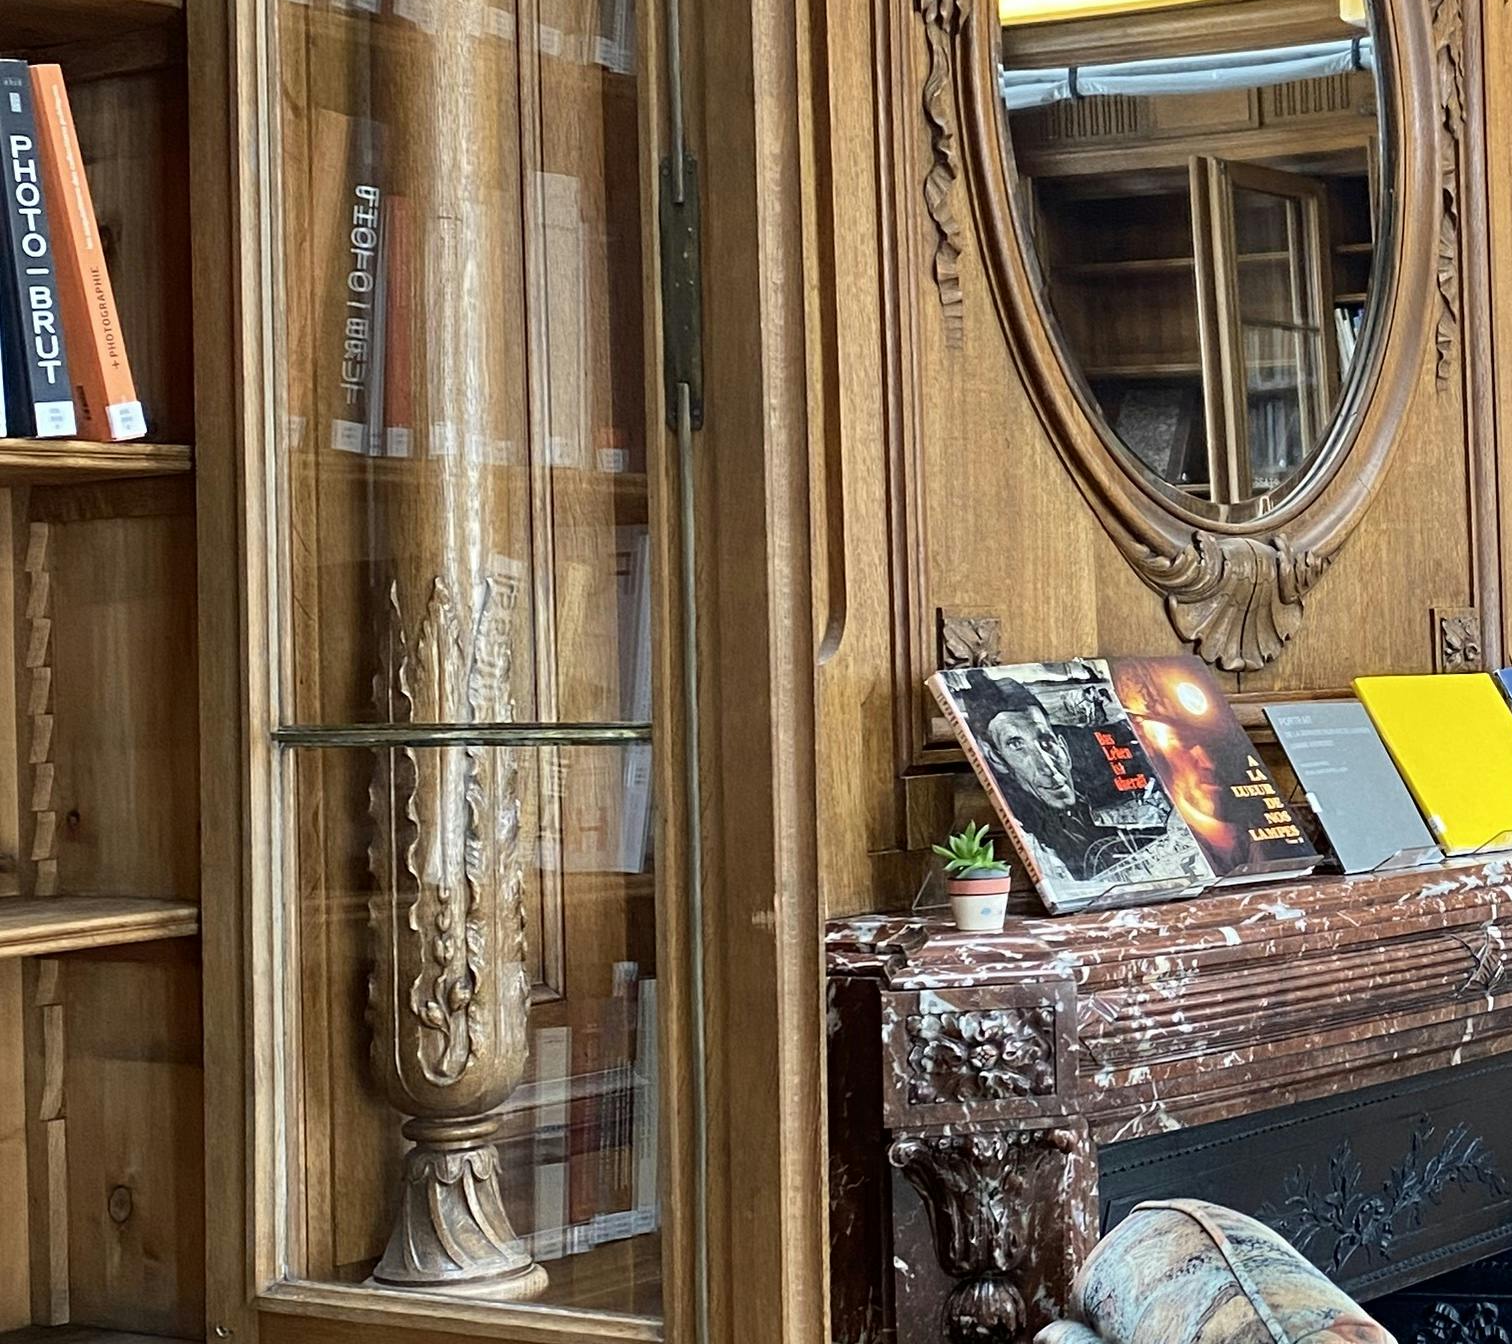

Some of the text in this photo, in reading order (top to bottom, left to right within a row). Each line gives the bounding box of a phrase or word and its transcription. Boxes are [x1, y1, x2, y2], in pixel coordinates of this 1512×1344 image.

[10, 134, 48, 258] PHOTO
[29, 285, 62, 384] BRUT
[92, 265, 117, 360] PHOTOGRAPHIE
[1247, 755, 1260, 767] A
[1246, 769, 1267, 782] LA
[1230, 783, 1276, 798] LUEUR
[1263, 797, 1285, 811] DE
[1264, 810, 1292, 825] NOS
[1248, 825, 1300, 842] LAMPES
